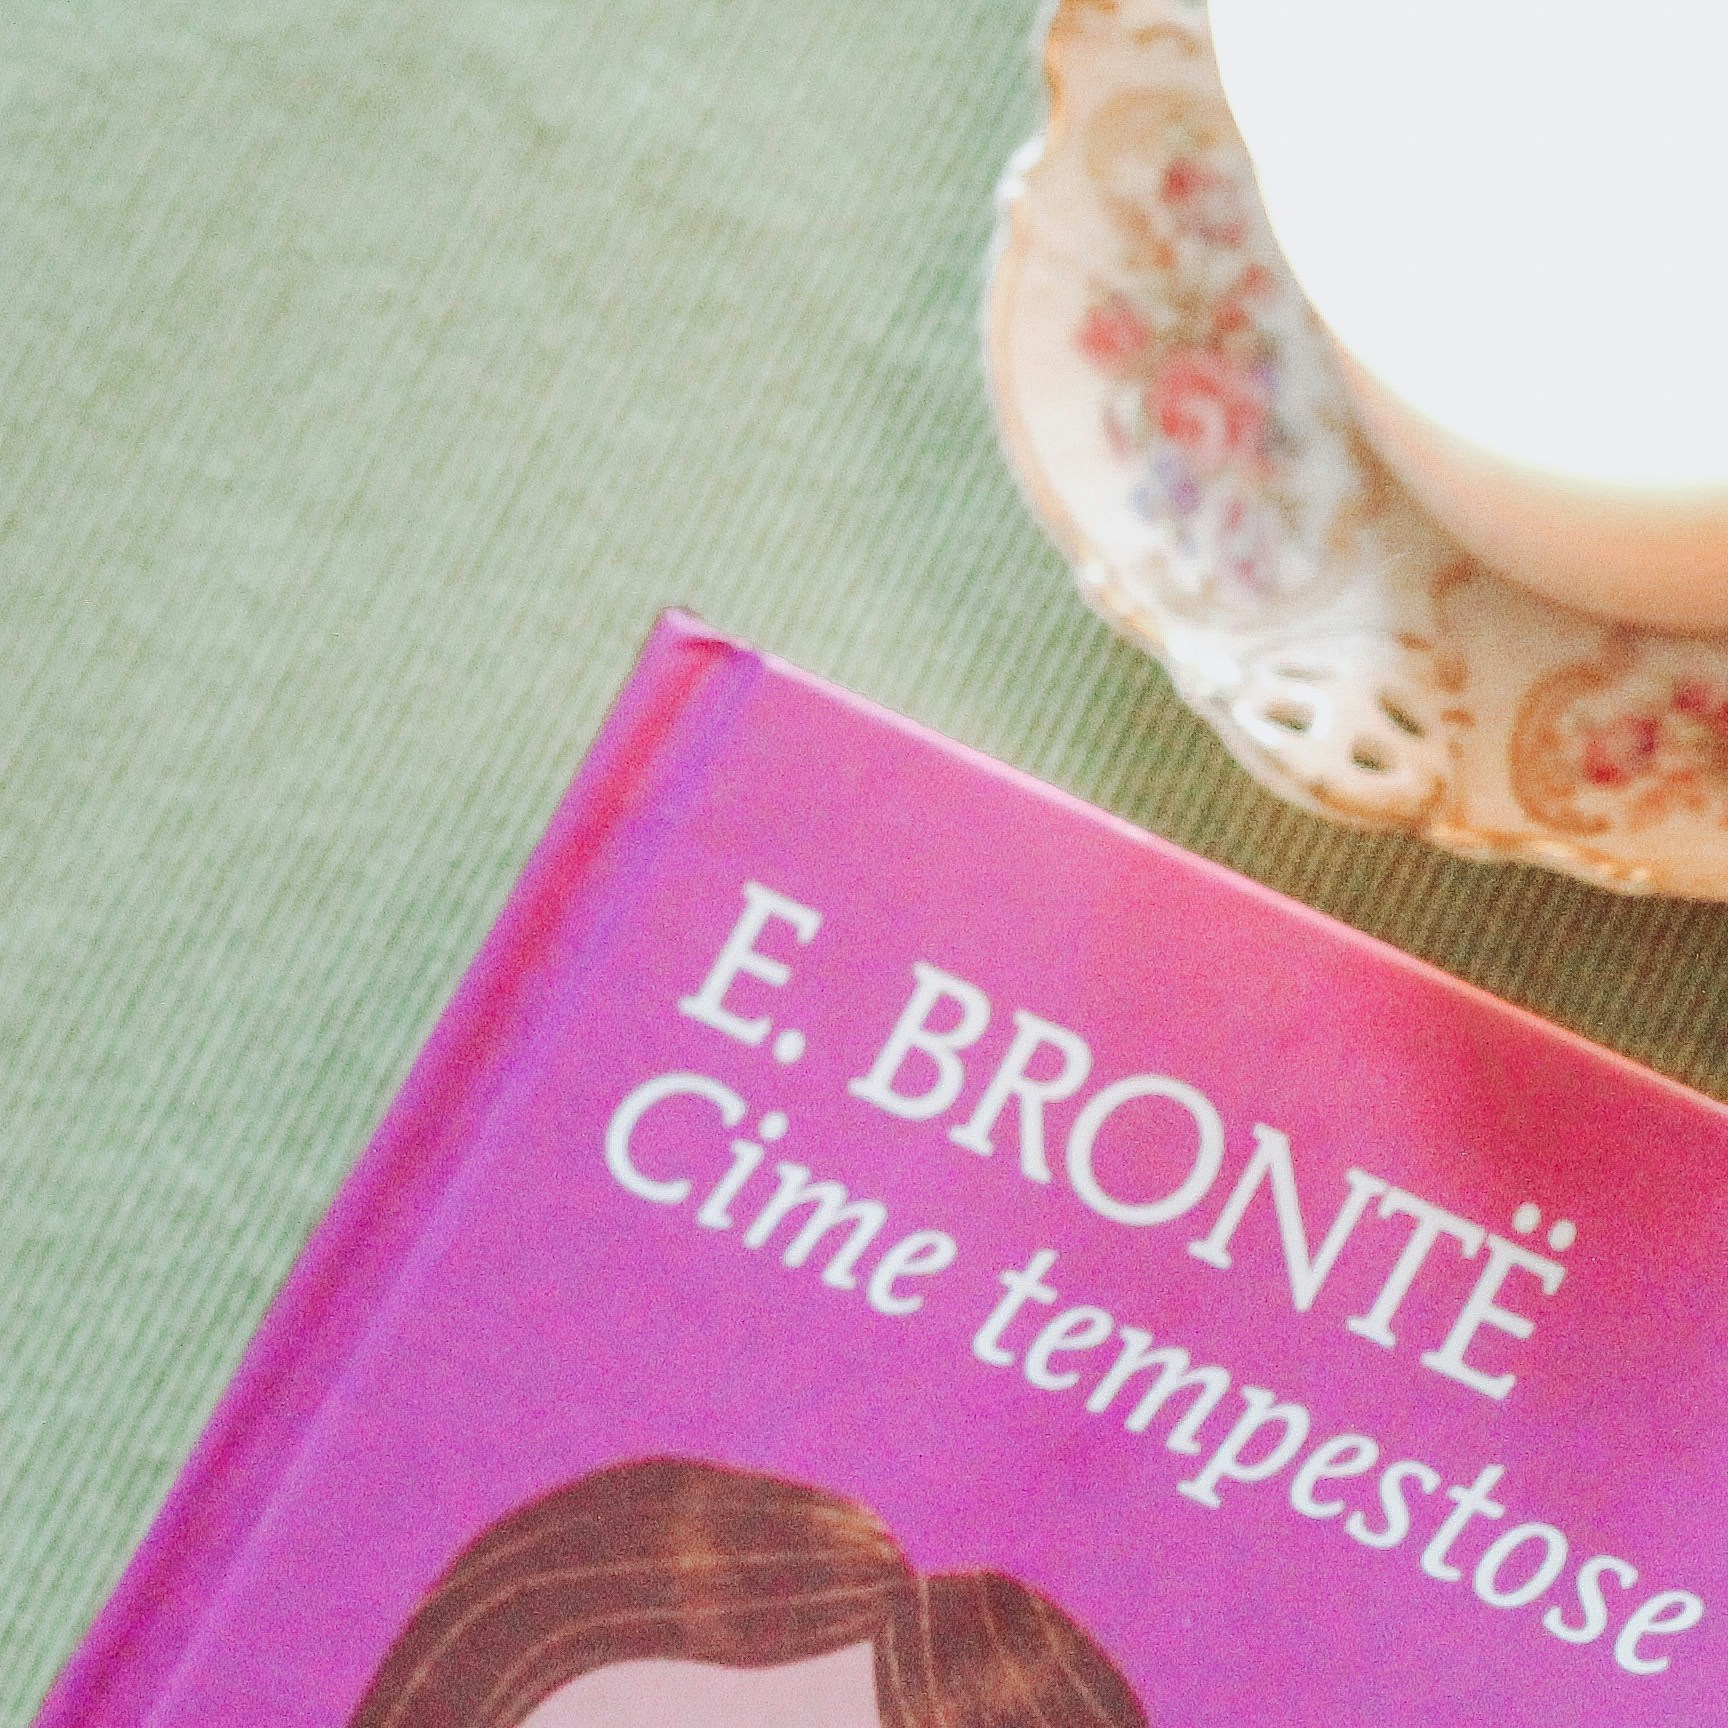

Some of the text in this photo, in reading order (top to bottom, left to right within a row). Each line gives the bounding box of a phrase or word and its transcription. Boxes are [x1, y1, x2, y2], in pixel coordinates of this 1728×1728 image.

[603, 1070, 1706, 1677] Cime tempestose
[676, 879, 1577, 1402] E. BRONTË
